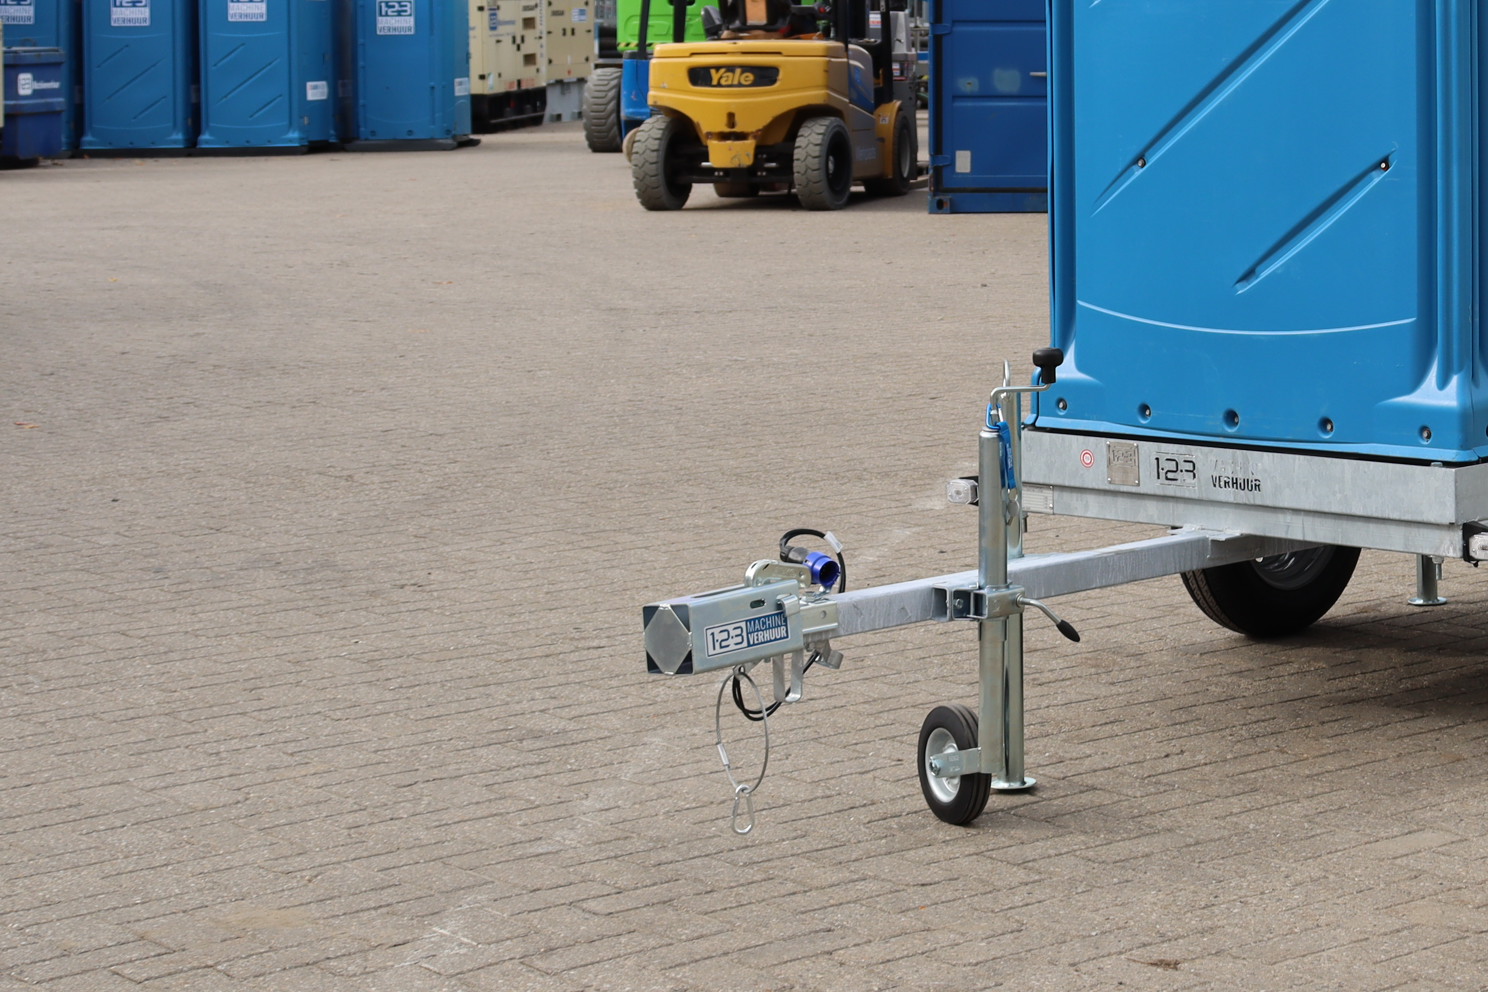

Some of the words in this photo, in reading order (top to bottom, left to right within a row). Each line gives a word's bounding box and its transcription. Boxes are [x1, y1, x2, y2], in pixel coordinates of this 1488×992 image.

[112, 16, 148, 25] VERHUUR
[229, 12, 265, 21] VERHUUR
[378, 26, 413, 34] VERHUUR
[709, 68, 755, 86] Yale
[1211, 474, 1262, 493] VERHUUR
[747, 613, 787, 633] MACHINE
[748, 625, 787, 645] VERHUUR
